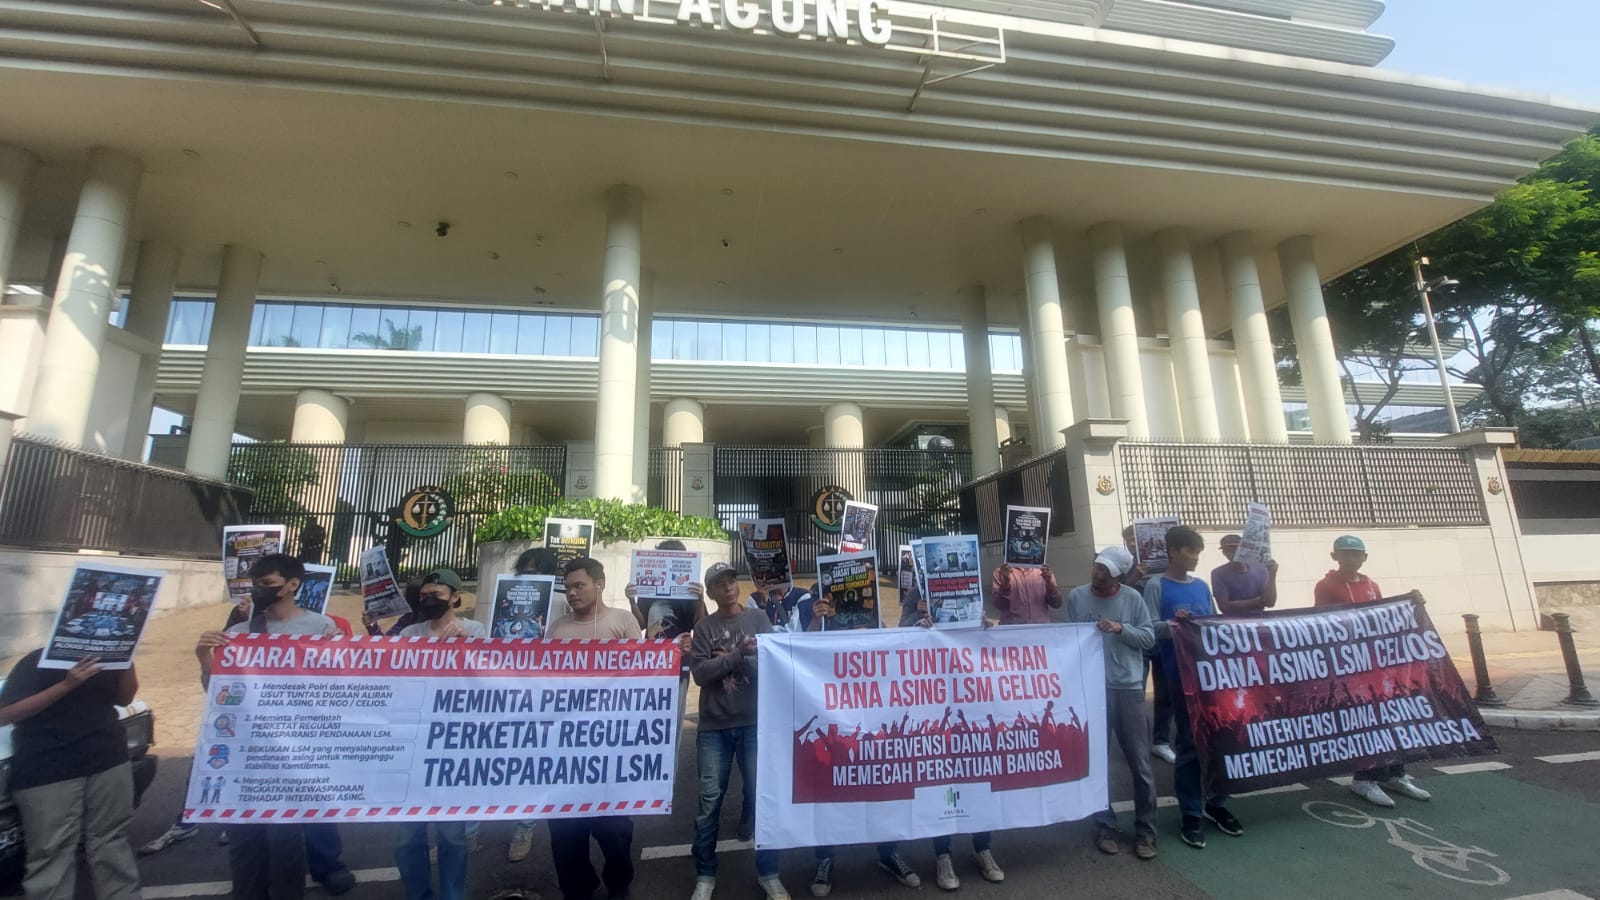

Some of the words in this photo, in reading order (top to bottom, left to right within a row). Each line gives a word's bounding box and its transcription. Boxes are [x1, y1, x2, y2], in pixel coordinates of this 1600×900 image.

[1202, 623, 1263, 656] USUT
[1266, 614, 1348, 649] TUNTAS
[1350, 601, 1418, 640] ALIRAN
[220, 645, 296, 668] SUARA
[302, 646, 387, 670] RAKYAT
[390, 649, 457, 670] UNTUK
[463, 649, 590, 670] KEDAULATAN
[594, 650, 674, 670] NEGARA!
[833, 650, 889, 679] USUT
[895, 647, 973, 676] TUNTAS
[979, 645, 1048, 673] ALIRAN
[1196, 658, 1264, 692] DANA
[1268, 648, 1329, 685] ASING
[1330, 641, 1373, 677] LSM
[1374, 630, 1447, 667] CELIOS
[347, 684, 392, 692] Kejaksaan:
[432, 689, 533, 713] MEMINTA
[540, 688, 672, 712] PEMERINTAH
[824, 680, 883, 710] DANA
[888, 677, 947, 707] ASING
[953, 675, 994, 704] LSM
[997, 672, 1062, 701] CELIOS
[258, 699, 284, 707] DANA
[286, 699, 314, 707] ASING
[316, 699, 328, 707] KE
[329, 699, 348, 707] NGO
[356, 699, 388, 707] CELIOS.
[252, 722, 297, 730] PERKETAT
[299, 722, 341, 730] REGULASI
[254, 714, 292, 722] Meminta
[294, 714, 342, 722] Pemerintah
[1246, 713, 1337, 748] INTERVENSI
[1341, 707, 1378, 732] DANA
[1380, 695, 1434, 725] ASING
[250, 730, 317, 738] TRANSPARANSI
[319, 730, 371, 738] PENDANAAN
[373, 730, 392, 738] LSM.
[426, 720, 555, 750] PERKETAT
[558, 718, 671, 747] REGULASI
[859, 733, 946, 761] INTERVENSI
[950, 732, 992, 754] DANA
[995, 729, 1039, 751] ASING
[246, 754, 290, 762] pendanaan
[292, 754, 314, 762] asing
[316, 753, 340, 761] untuk
[342, 754, 394, 762] mengganggu
[312, 746, 333, 754] yang
[334, 744, 405, 754] menyalahgunakan
[1224, 750, 1308, 780] MEMECAH
[1310, 729, 1397, 767] PERSATUAN
[1395, 718, 1482, 750] BANGSA
[244, 762, 280, 770] stabilitas
[281, 762, 330, 770] Kamtibmas.
[424, 756, 609, 787] TRANSPARANSI
[615, 753, 669, 783] LSM.
[832, 760, 913, 787] MEMECAH
[917, 755, 1003, 783] PERSATUAN
[1006, 749, 1063, 775] BANGSA
[240, 785, 293, 793] TINGKATKAN
[296, 784, 364, 792] KEWASPADAAN
[242, 777, 280, 786] Mengajak
[282, 777, 330, 786] masyarakat
[238, 794, 284, 802] TERHADAP
[285, 794, 336, 802] INTERVENSI
[337, 793, 366, 801] ASING.
